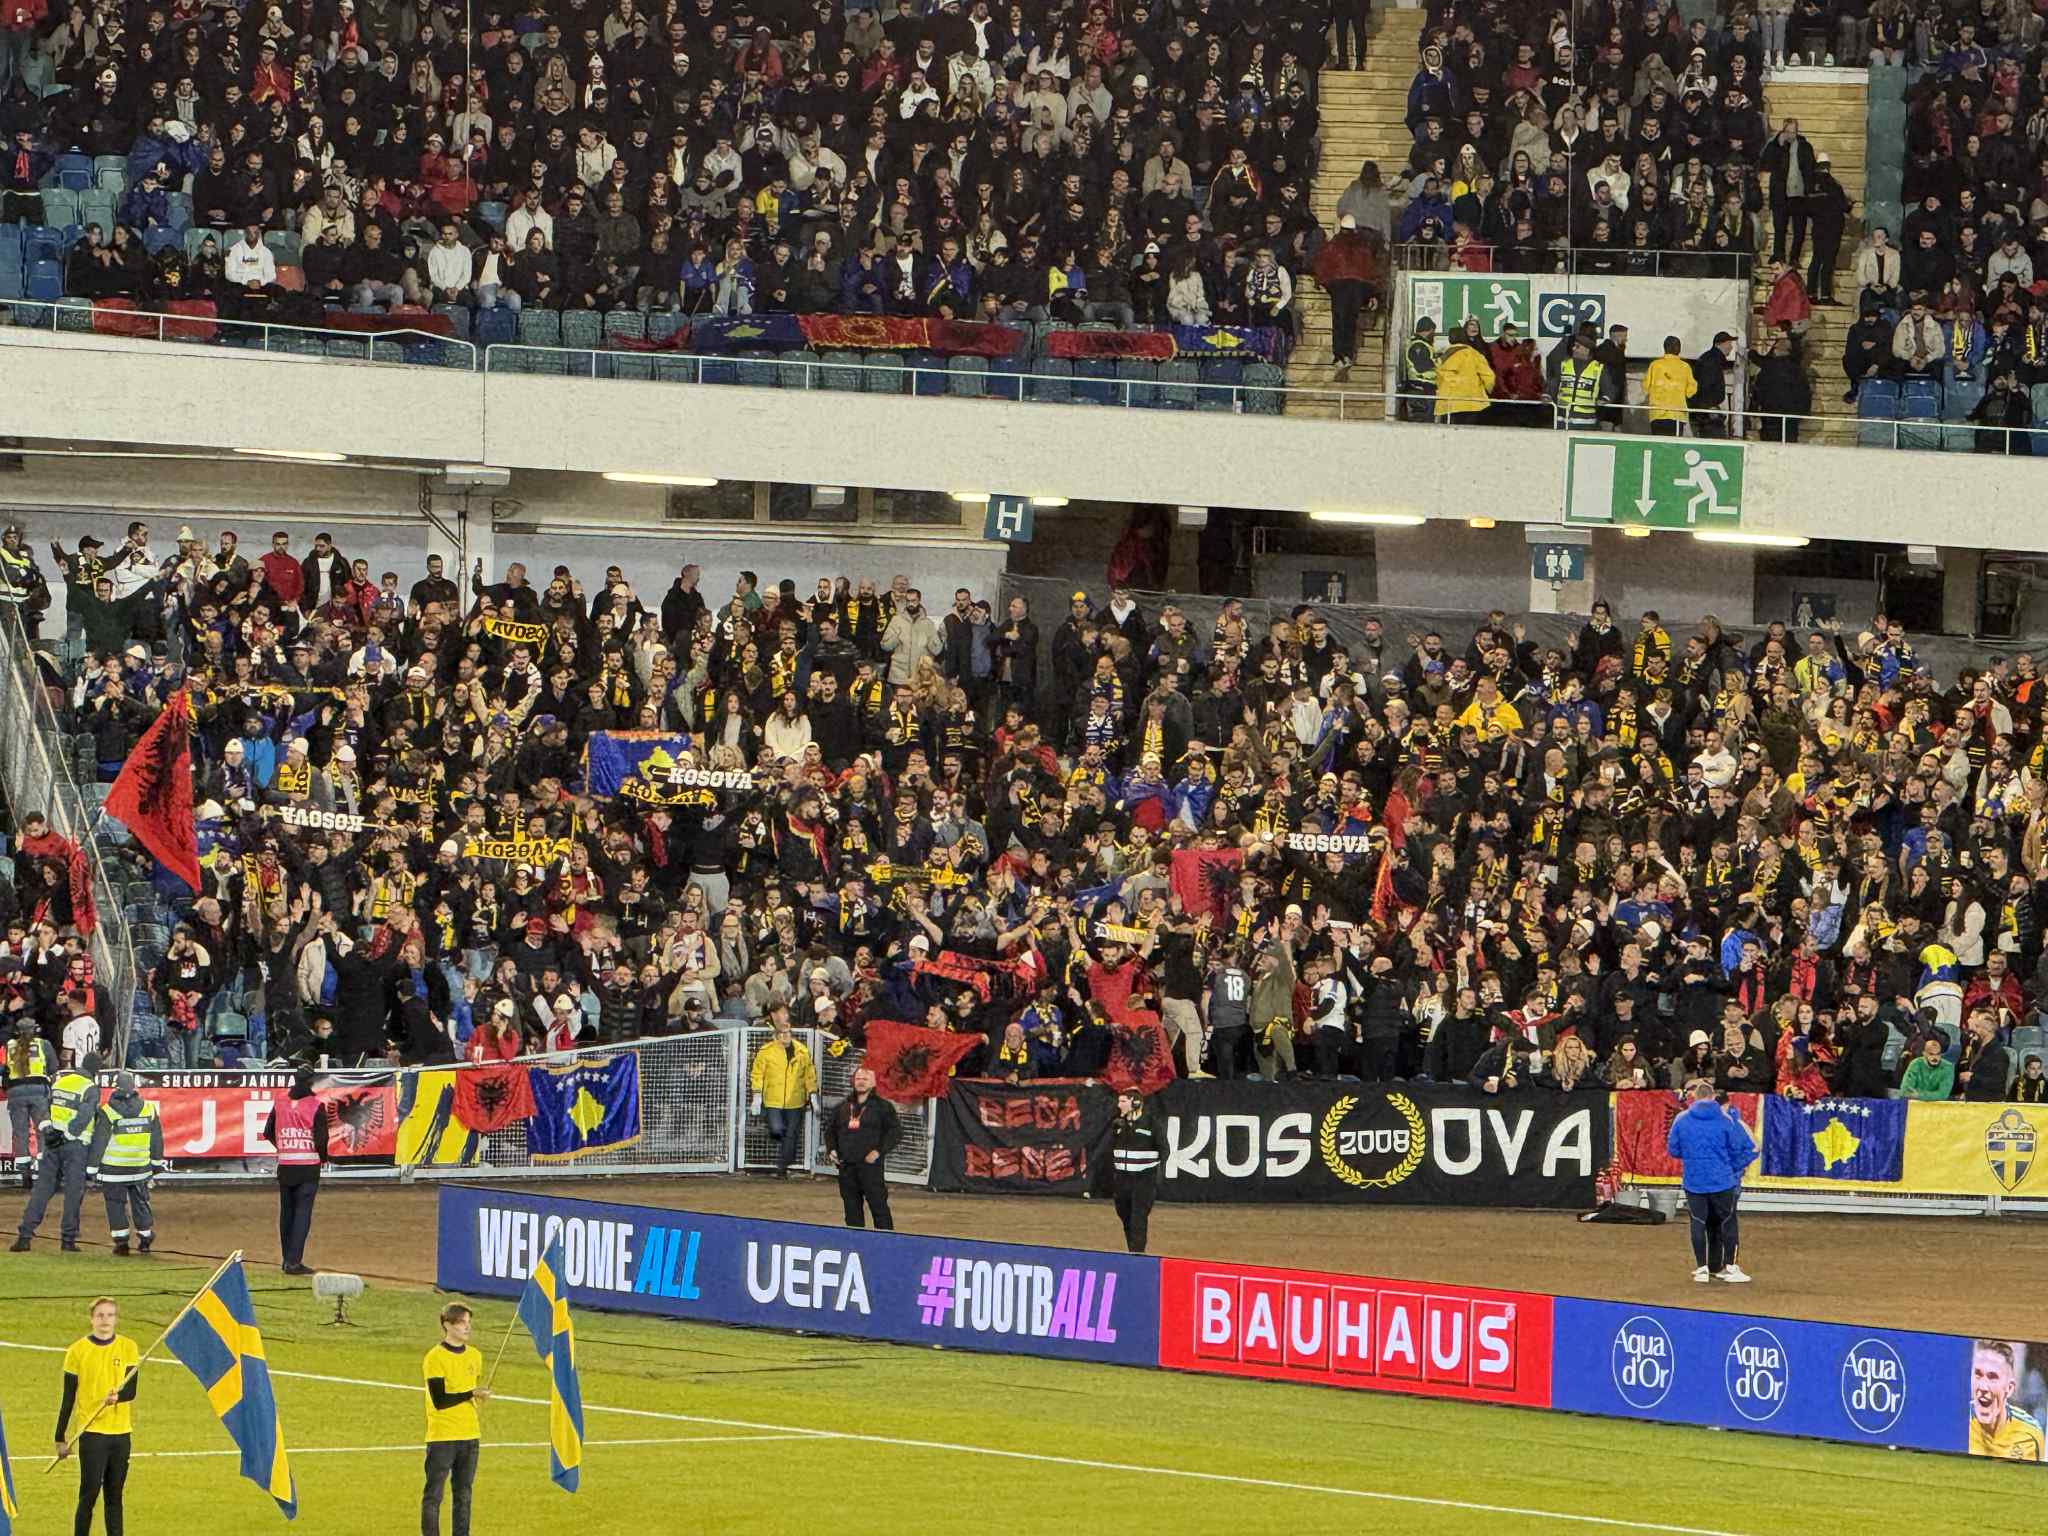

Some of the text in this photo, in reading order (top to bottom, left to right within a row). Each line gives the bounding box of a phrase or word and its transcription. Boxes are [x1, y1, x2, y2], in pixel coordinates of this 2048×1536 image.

[1542, 298, 1603, 333] G2
[997, 501, 1023, 531] H
[667, 767, 752, 790] KOSOVA
[280, 806, 364, 832] KOSOVA
[1288, 833, 1370, 853] KOSOVA
[1224, 976, 1245, 1001] 18
[162, 1074, 219, 1088] SHKUPI
[240, 1074, 296, 1088] JANINA
[1338, 1128, 1410, 1156] 2008
[634, 1226, 701, 1299] ALL
[747, 1241, 871, 1314] UEFA
[917, 1256, 1117, 1343] #FOOTBALL
[1202, 1287, 1510, 1374] BAUHAUS
[1615, 1327, 1666, 1362] Aqua
[1728, 1340, 1780, 1374] Aqua
[1845, 1352, 1897, 1387] Aqua
[1622, 1358, 1669, 1388] d'Or
[1735, 1369, 1783, 1401] d'Or
[1852, 1382, 1900, 1413] d'Or
